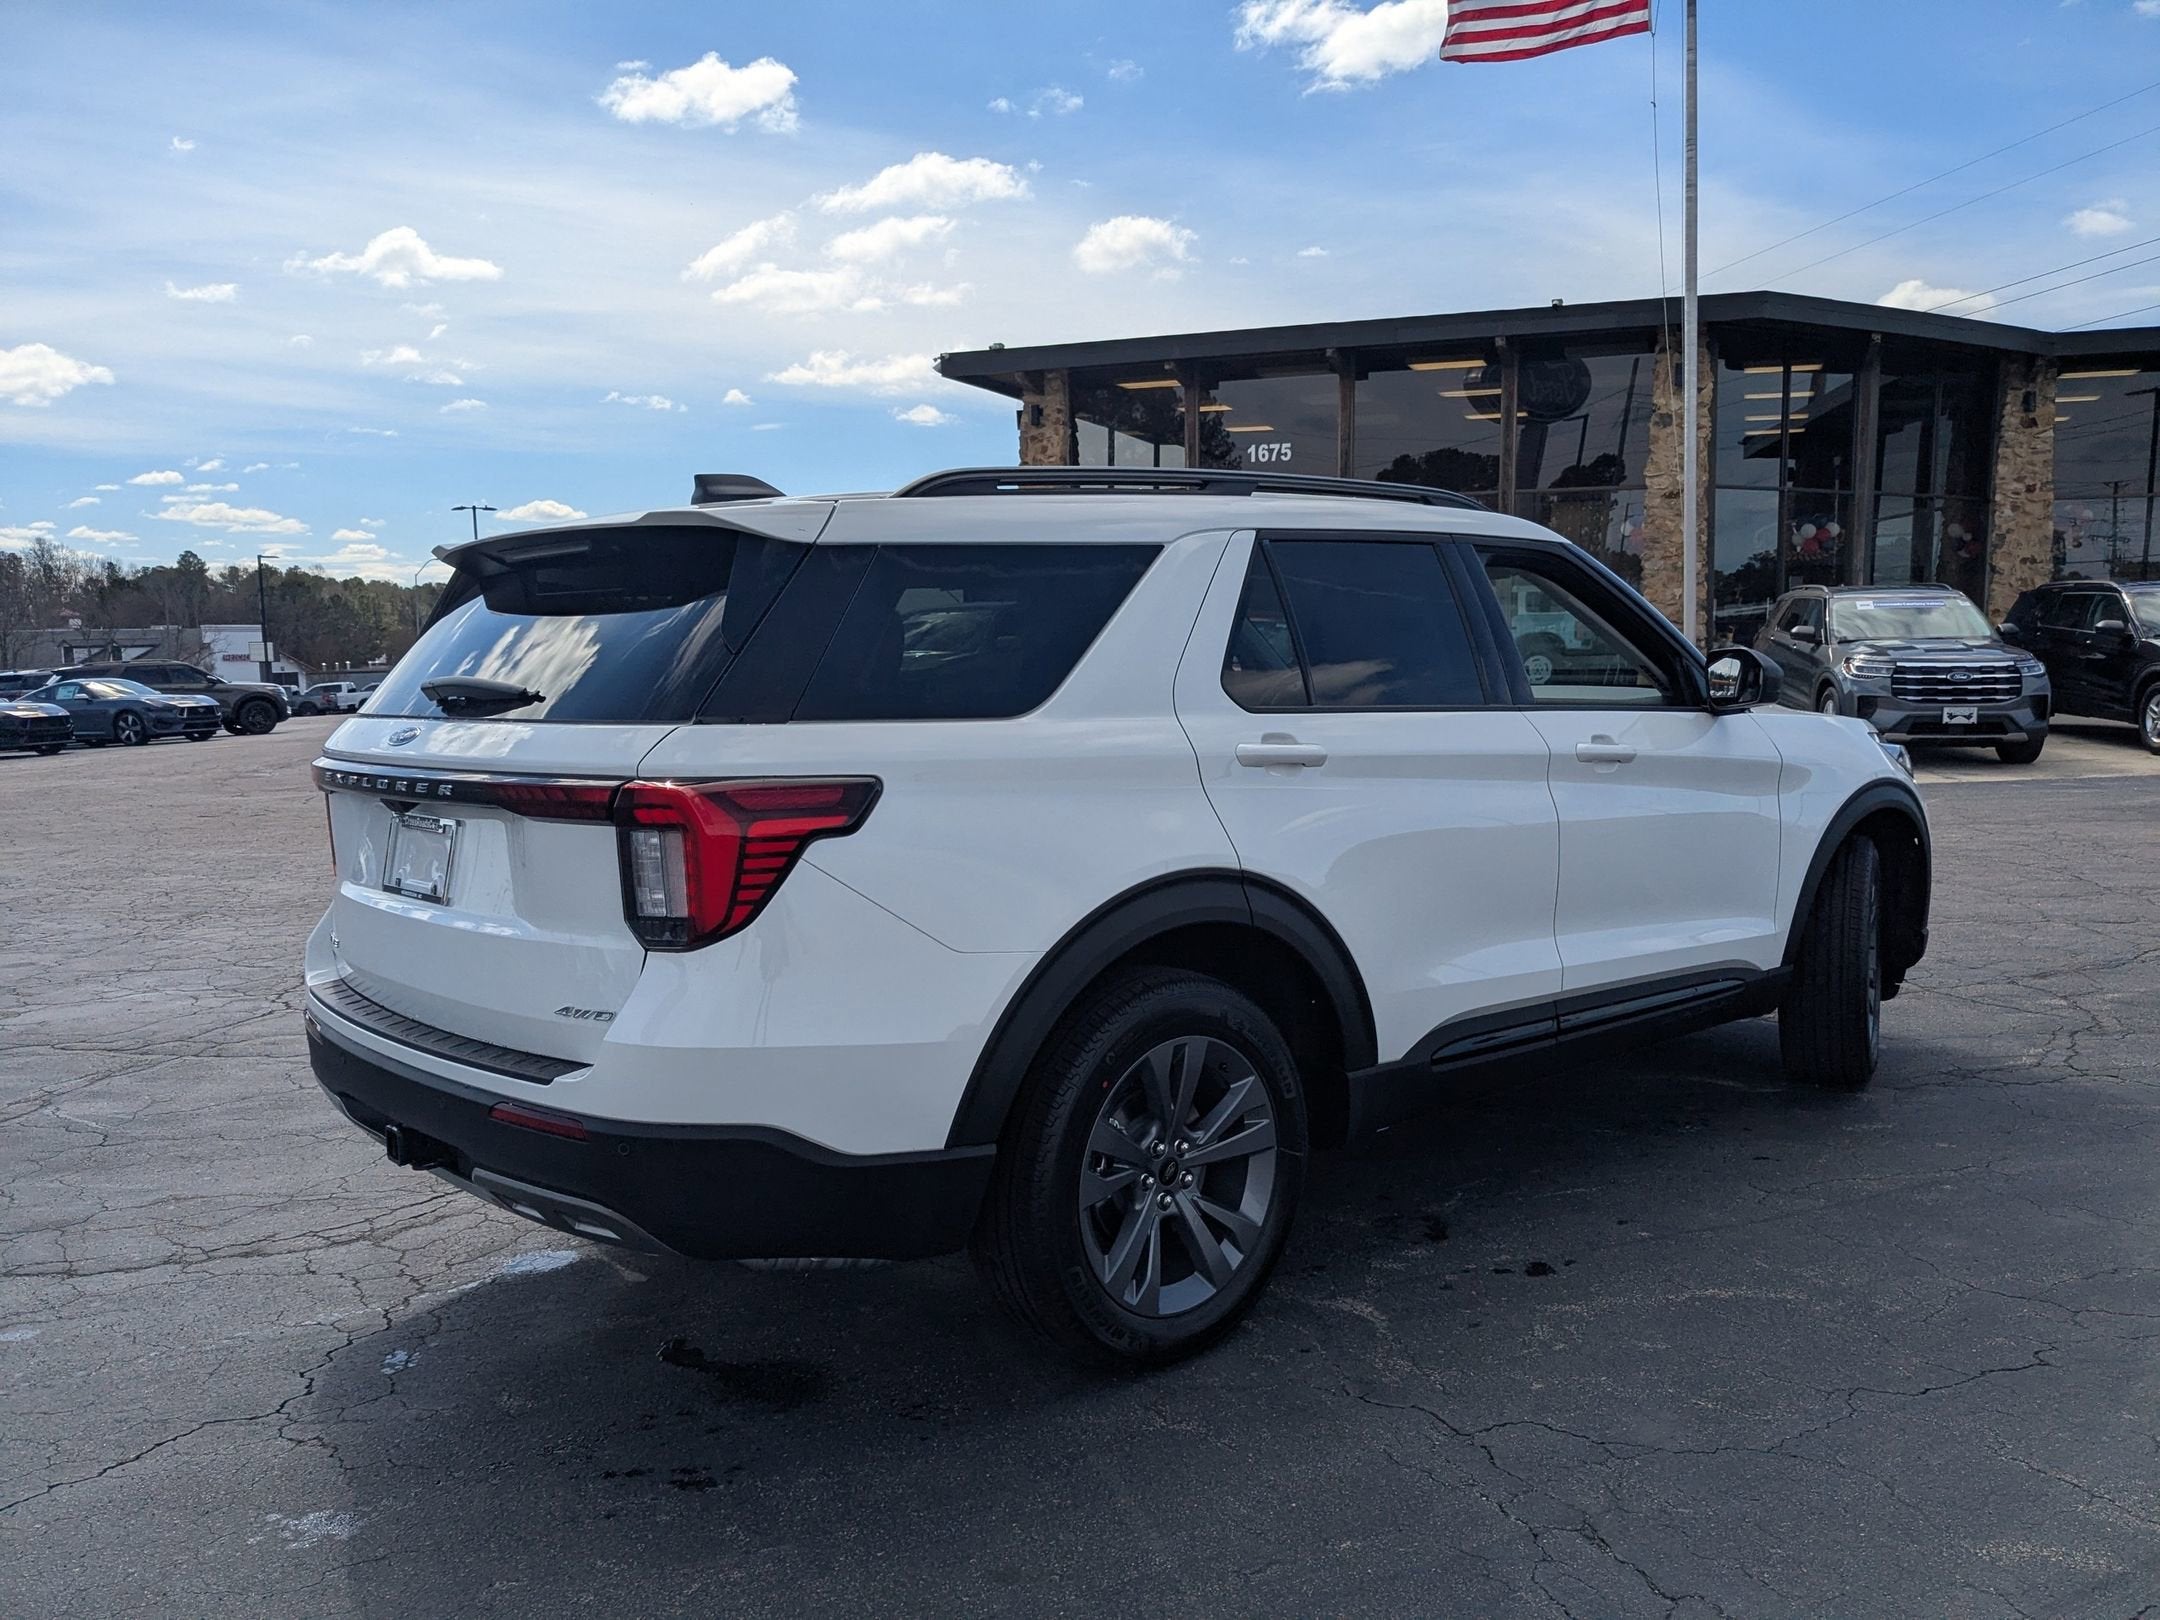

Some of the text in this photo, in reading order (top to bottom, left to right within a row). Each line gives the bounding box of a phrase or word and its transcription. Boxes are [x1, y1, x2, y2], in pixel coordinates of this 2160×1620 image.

[1247, 443, 1292, 463] 1675
[324, 772, 453, 796] EXPLORER
[553, 1006, 616, 1022] AWD
